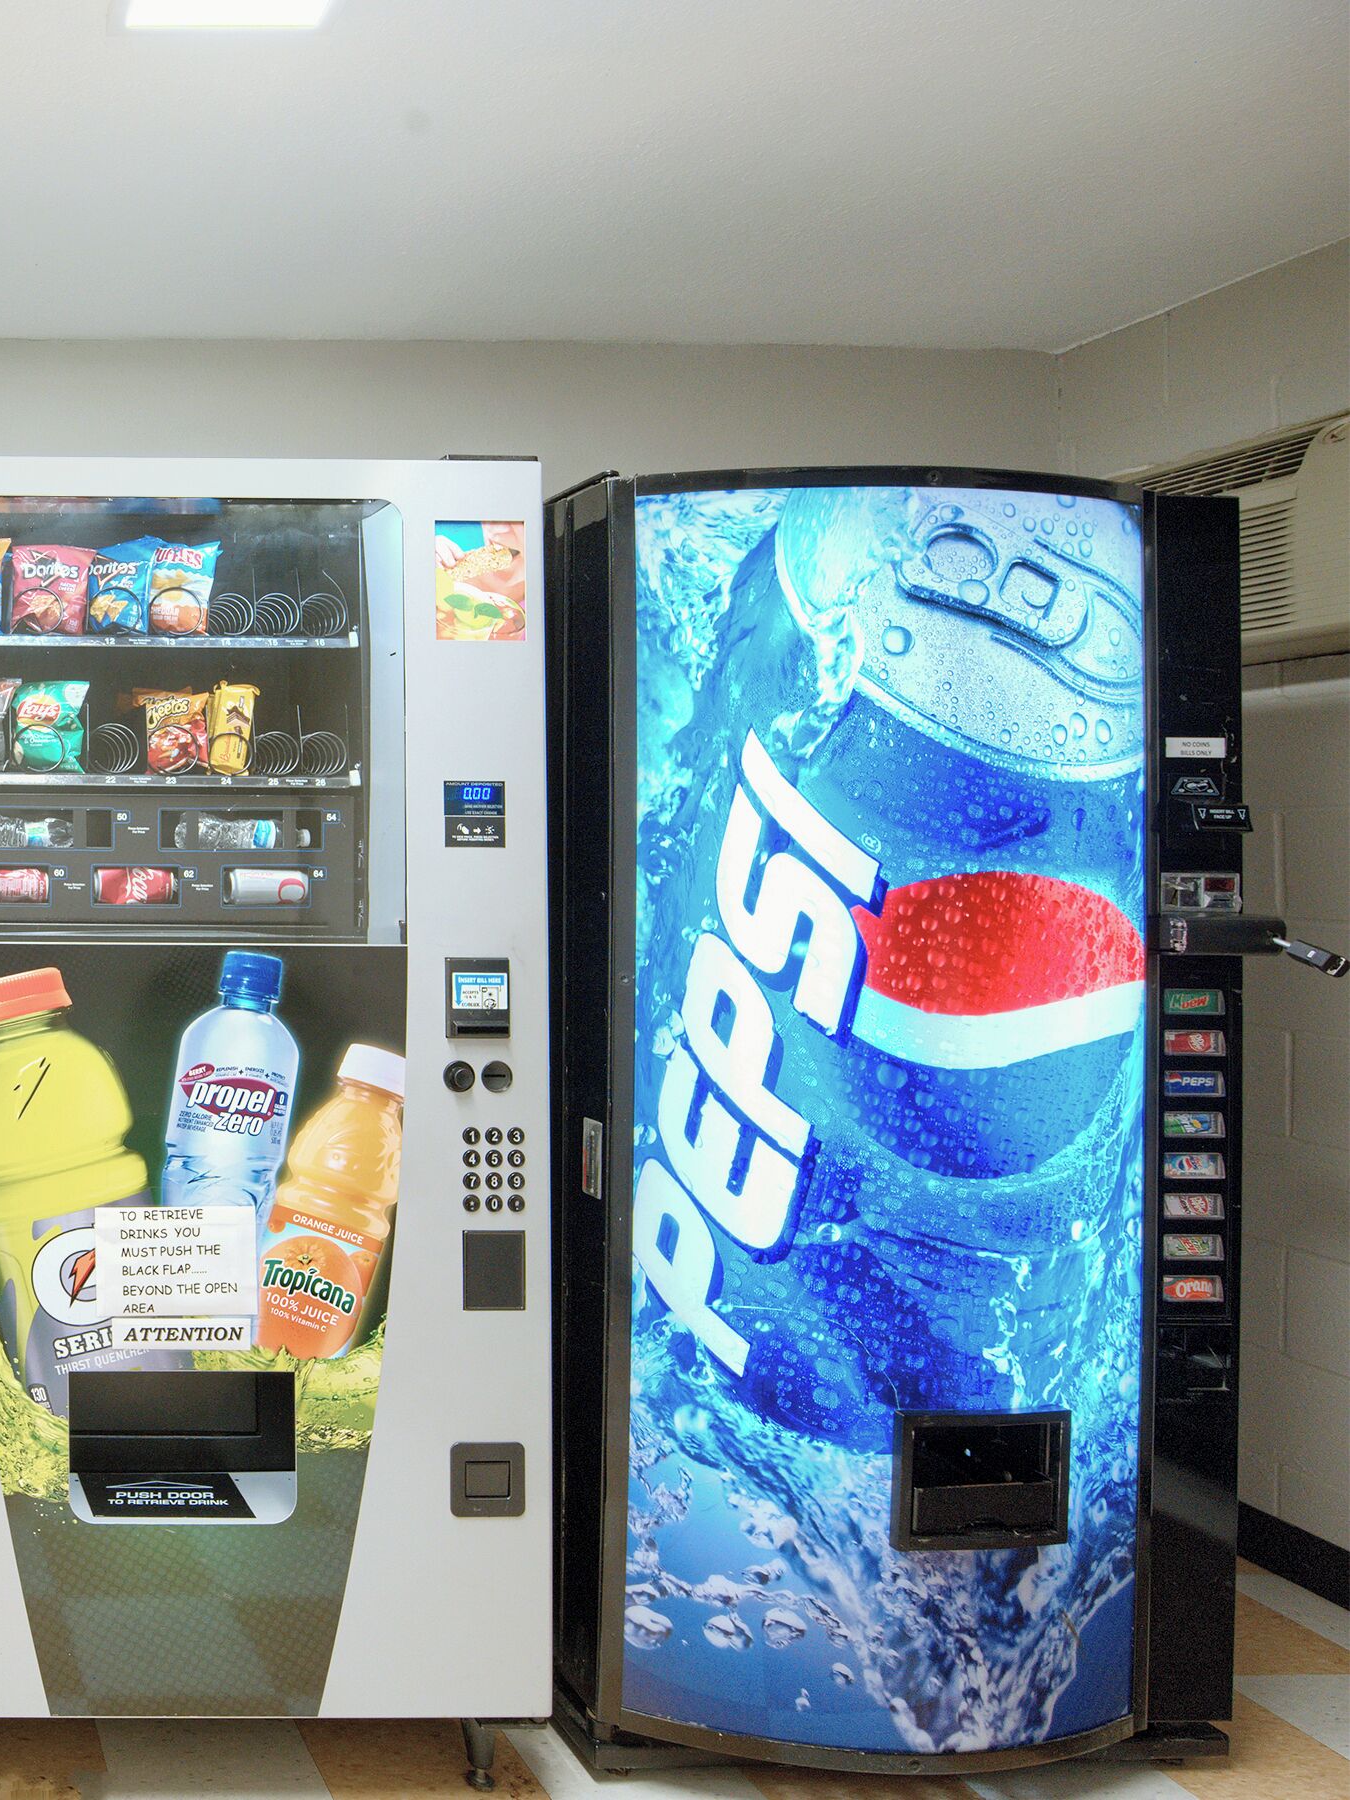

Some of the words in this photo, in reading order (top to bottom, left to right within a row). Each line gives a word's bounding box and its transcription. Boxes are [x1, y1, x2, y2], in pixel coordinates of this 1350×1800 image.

[23, 561, 79, 579] Doritos
[104, 637, 116, 645] 12
[17, 701, 59, 721] Lay's
[147, 698, 189, 729] Cheetos
[105, 776, 116, 784] 22
[165, 776, 177, 784] 23
[221, 777, 232, 785] 24
[268, 778, 279, 786] 25
[117, 812, 128, 821] 50
[54, 868, 65, 877] 60
[183, 870, 195, 878] 62
[313, 870, 324, 878] 64
[633, 727, 881, 1379] PEPSI
[188, 1065, 207, 1077] BERRY
[1182, 1076, 1215, 1086] PEPSI
[186, 1081, 275, 1115] propel
[214, 1112, 264, 1136] zero
[469, 1131, 475, 1142] 1
[491, 1131, 498, 1142] 2
[513, 1131, 521, 1142] 3
[469, 1153, 476, 1165] 4
[491, 1153, 498, 1165] 5
[513, 1153, 521, 1165] 6
[469, 1176, 476, 1187] 7
[491, 1176, 498, 1187] 8
[513, 1176, 521, 1187] 9
[491, 1198, 498, 1209] 0
[120, 1211, 137, 1221] TO
[143, 1209, 203, 1221] RETRIEVE
[120, 1228, 168, 1240] DRINKS
[174, 1227, 201, 1238] YOU
[292, 1213, 336, 1234] ORANGE
[335, 1229, 364, 1245] JUICE
[121, 1247, 157, 1257] MUST
[160, 1245, 192, 1256] PUSH
[196, 1244, 220, 1255] THE
[122, 1265, 159, 1276] BLACK
[122, 1285, 172, 1296] BEYOND
[176, 1283, 200, 1294] THE
[204, 1283, 238, 1293] OPEN
[262, 1259, 356, 1315] Tropicana
[123, 1303, 155, 1314] AREA
[265, 1292, 299, 1312] 100%
[300, 1305, 340, 1326] JUICE
[270, 1307, 290, 1319] 100%
[320, 1325, 327, 1333] C
[123, 1326, 244, 1342] ATTENTION
[52, 1325, 112, 1360] SERI
[54, 1358, 90, 1376] THIRST
[31, 1387, 47, 1402] 130
[116, 1491, 162, 1499] PUSH
[167, 1491, 214, 1499] DOOR
